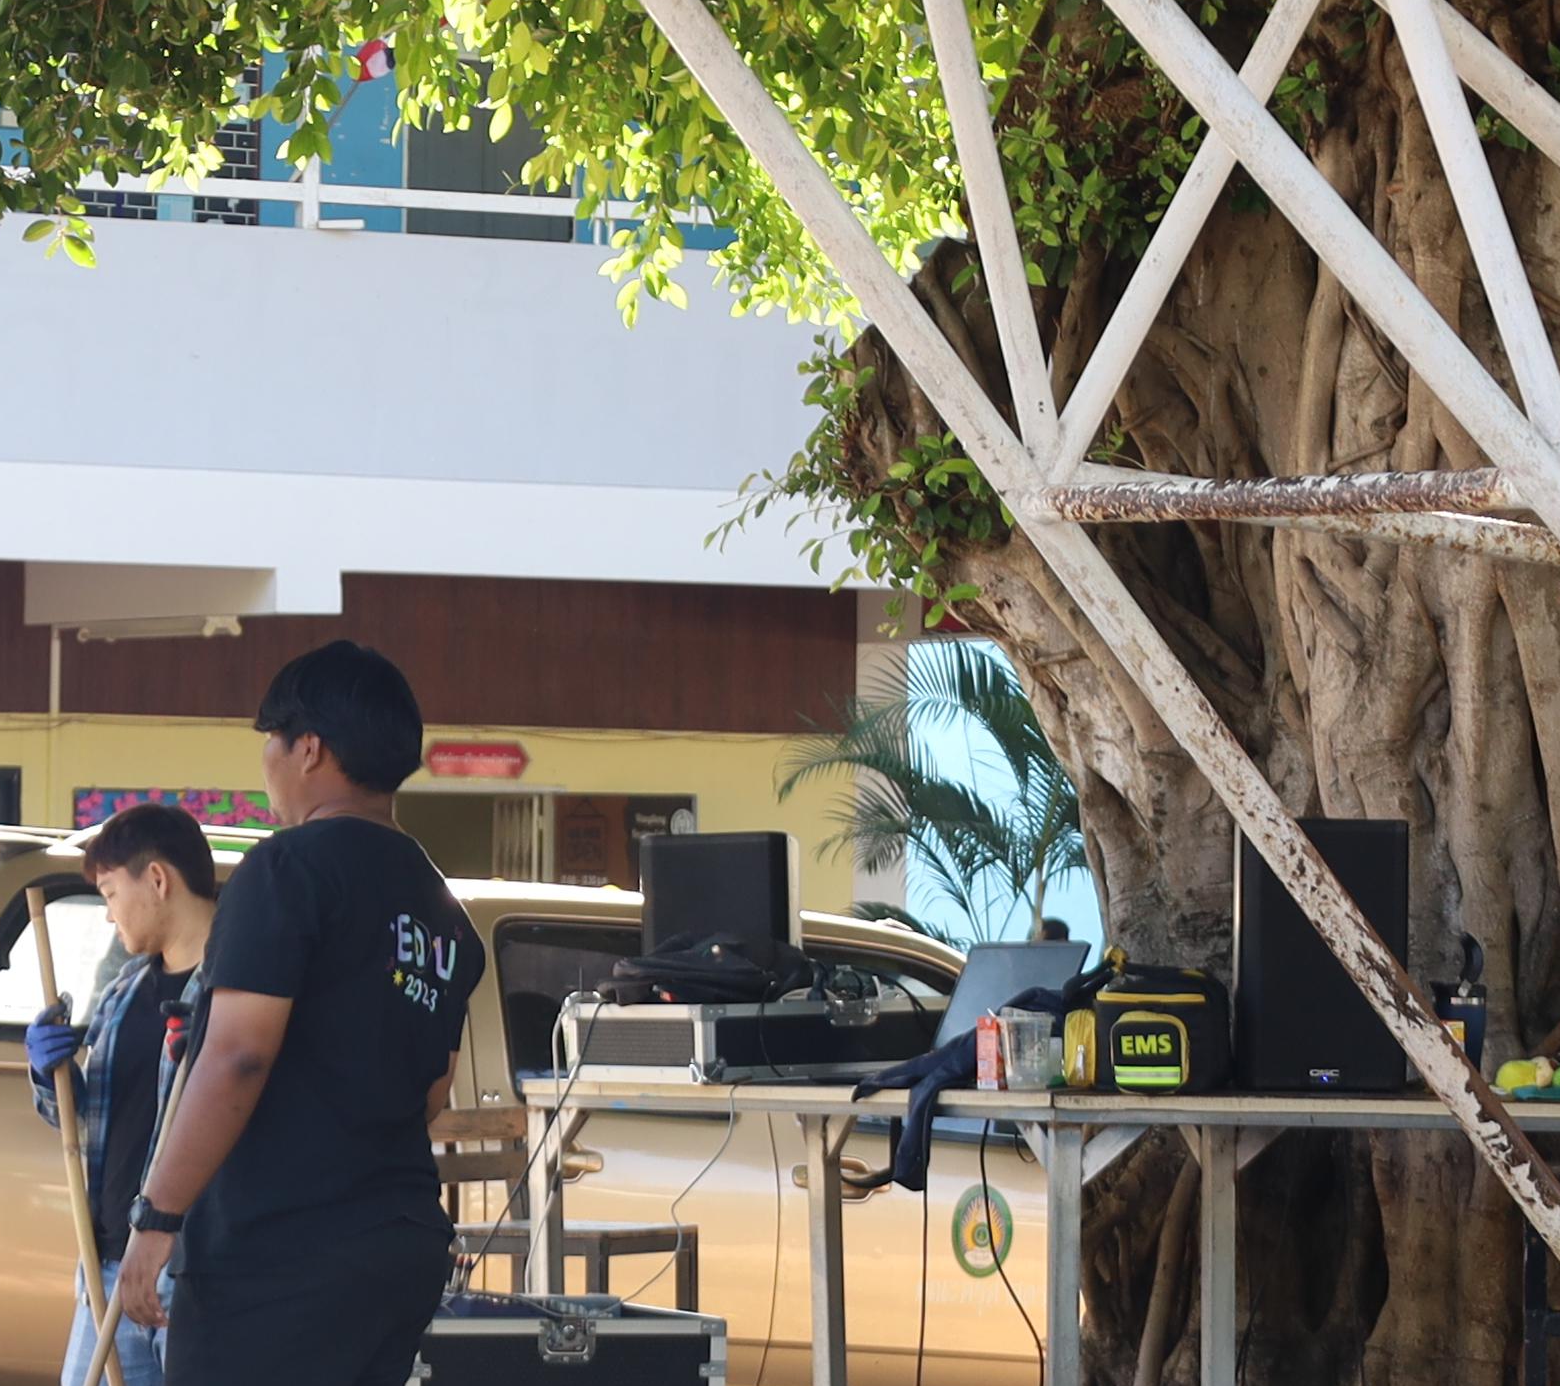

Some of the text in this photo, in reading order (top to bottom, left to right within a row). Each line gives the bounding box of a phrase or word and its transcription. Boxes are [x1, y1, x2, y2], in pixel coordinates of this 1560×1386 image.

[397, 913, 457, 981] EDU
[404, 973, 439, 1013] 2023
[1120, 1033, 1173, 1056] EMS
